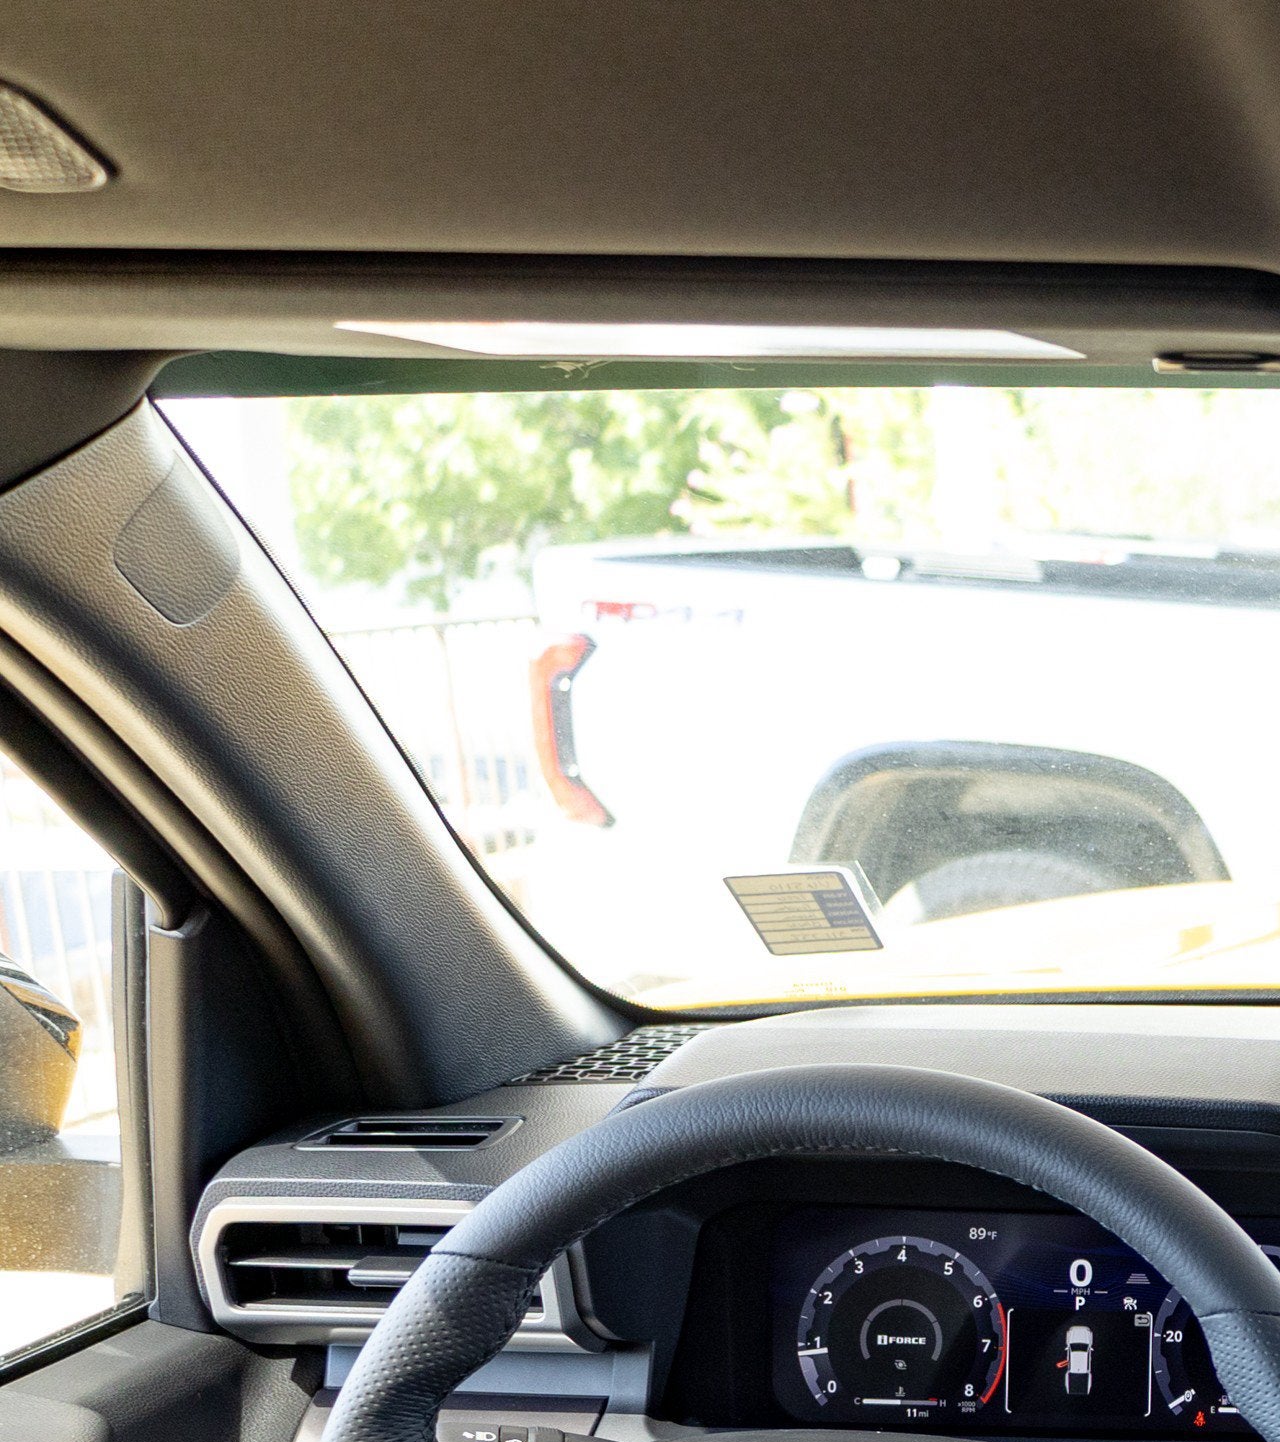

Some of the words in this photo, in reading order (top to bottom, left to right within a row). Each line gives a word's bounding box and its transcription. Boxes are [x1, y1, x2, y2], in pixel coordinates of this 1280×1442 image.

[897, 1250, 907, 1262] 4
[855, 1261, 864, 1274] 3
[944, 1262, 954, 1275] 5
[1069, 1259, 1093, 1287] 0
[823, 1292, 833, 1304] 2
[1070, 1287, 1090, 1296] MPH
[973, 1296, 982, 1308] 6
[1075, 1297, 1086, 1310] P
[813, 1337, 821, 1348] 1
[1166, 1330, 1182, 1342] 20
[981, 1340, 991, 1353] 7
[827, 1380, 837, 1393] 0
[964, 1384, 974, 1397] 8
